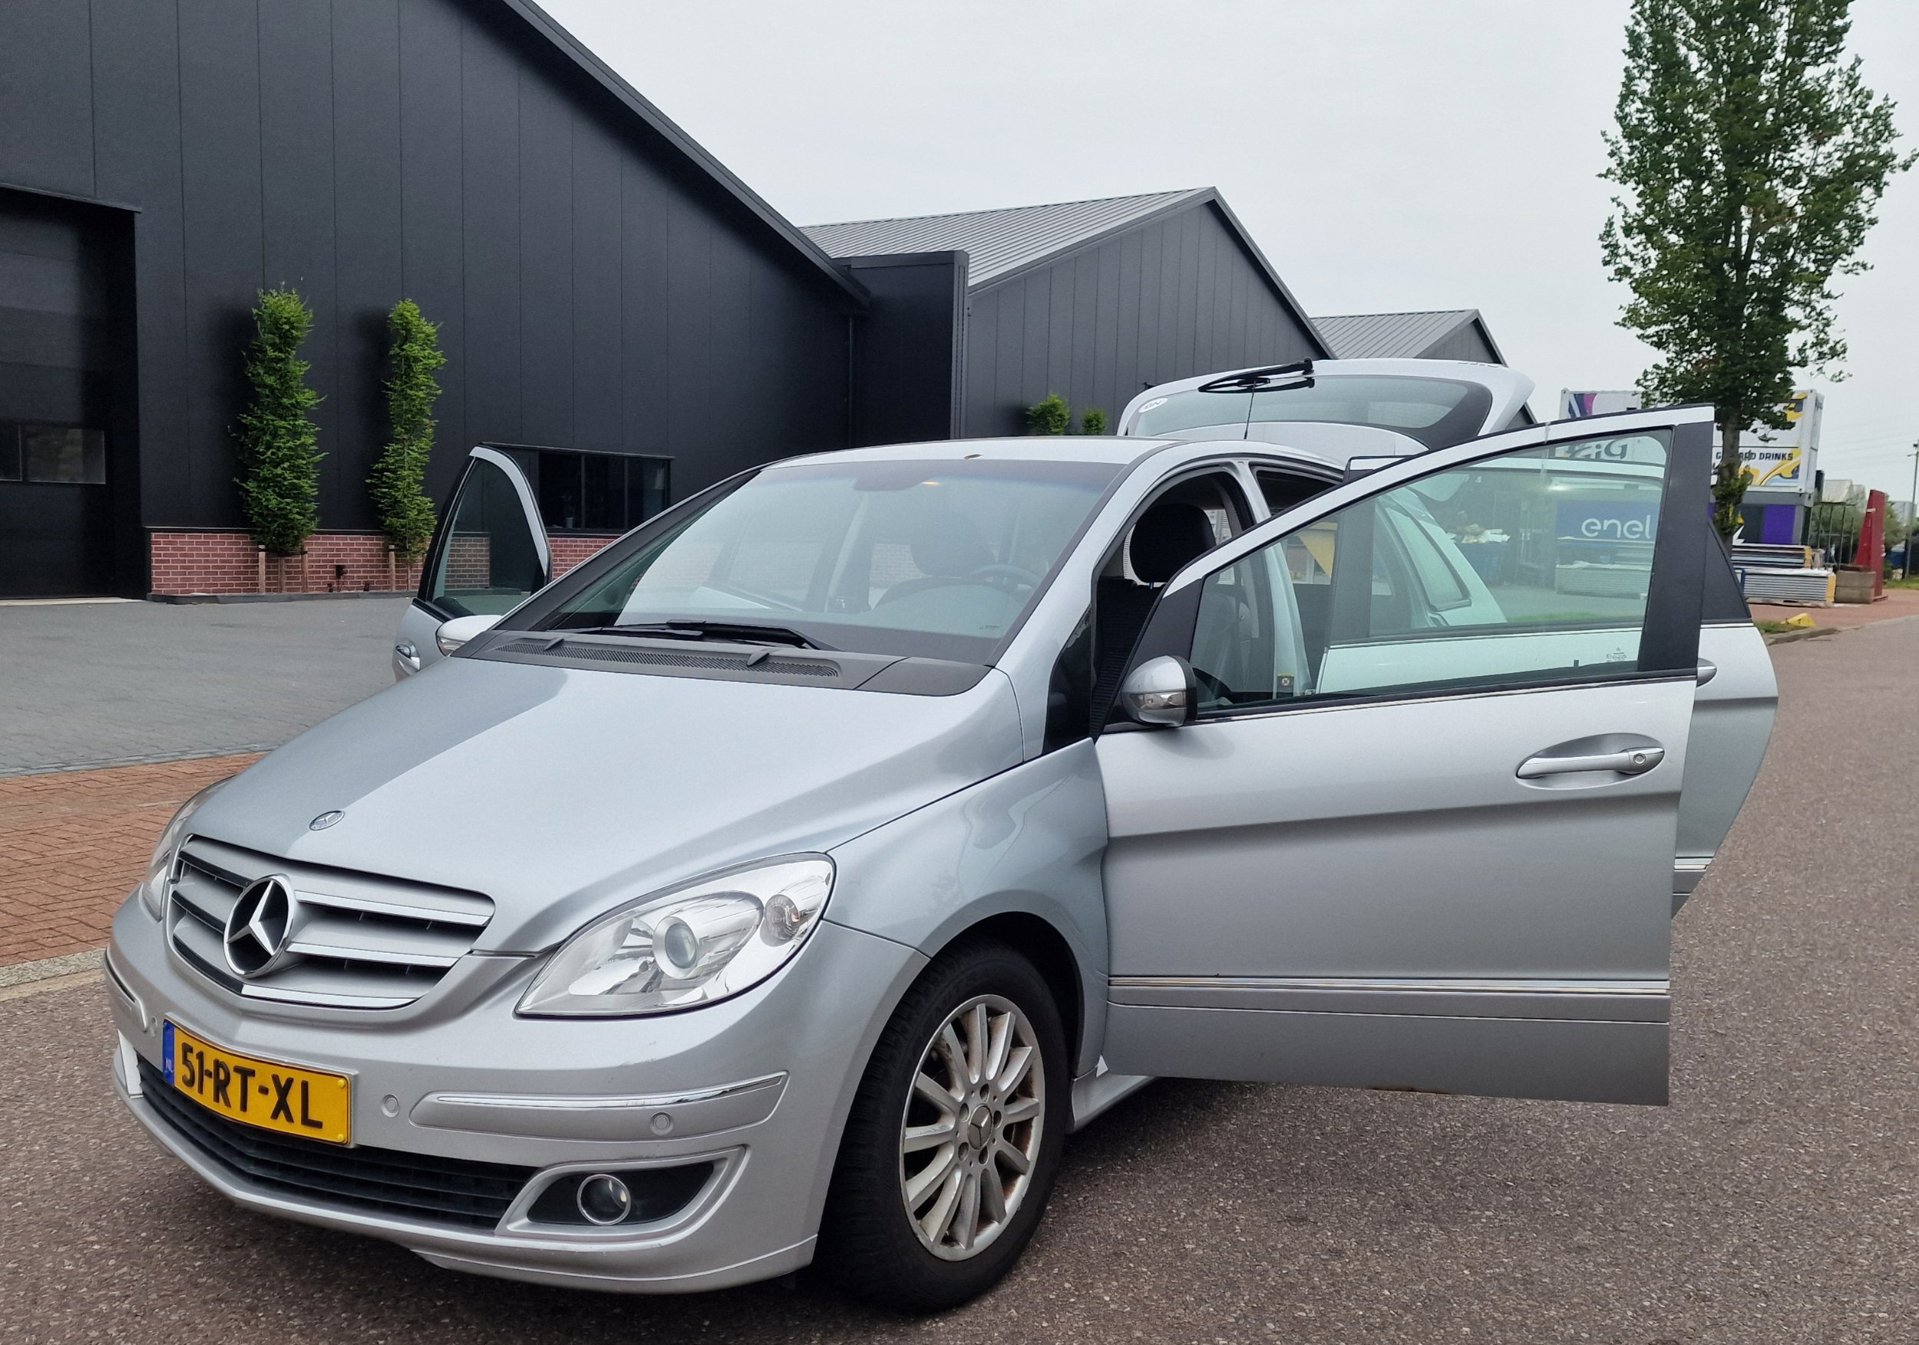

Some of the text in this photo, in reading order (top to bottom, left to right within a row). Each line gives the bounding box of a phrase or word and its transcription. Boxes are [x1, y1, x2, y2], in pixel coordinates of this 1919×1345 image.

[1759, 451, 1794, 461] DRINKS
[1581, 514, 1651, 539] enel
[181, 1041, 323, 1129] 51-RT-XL
